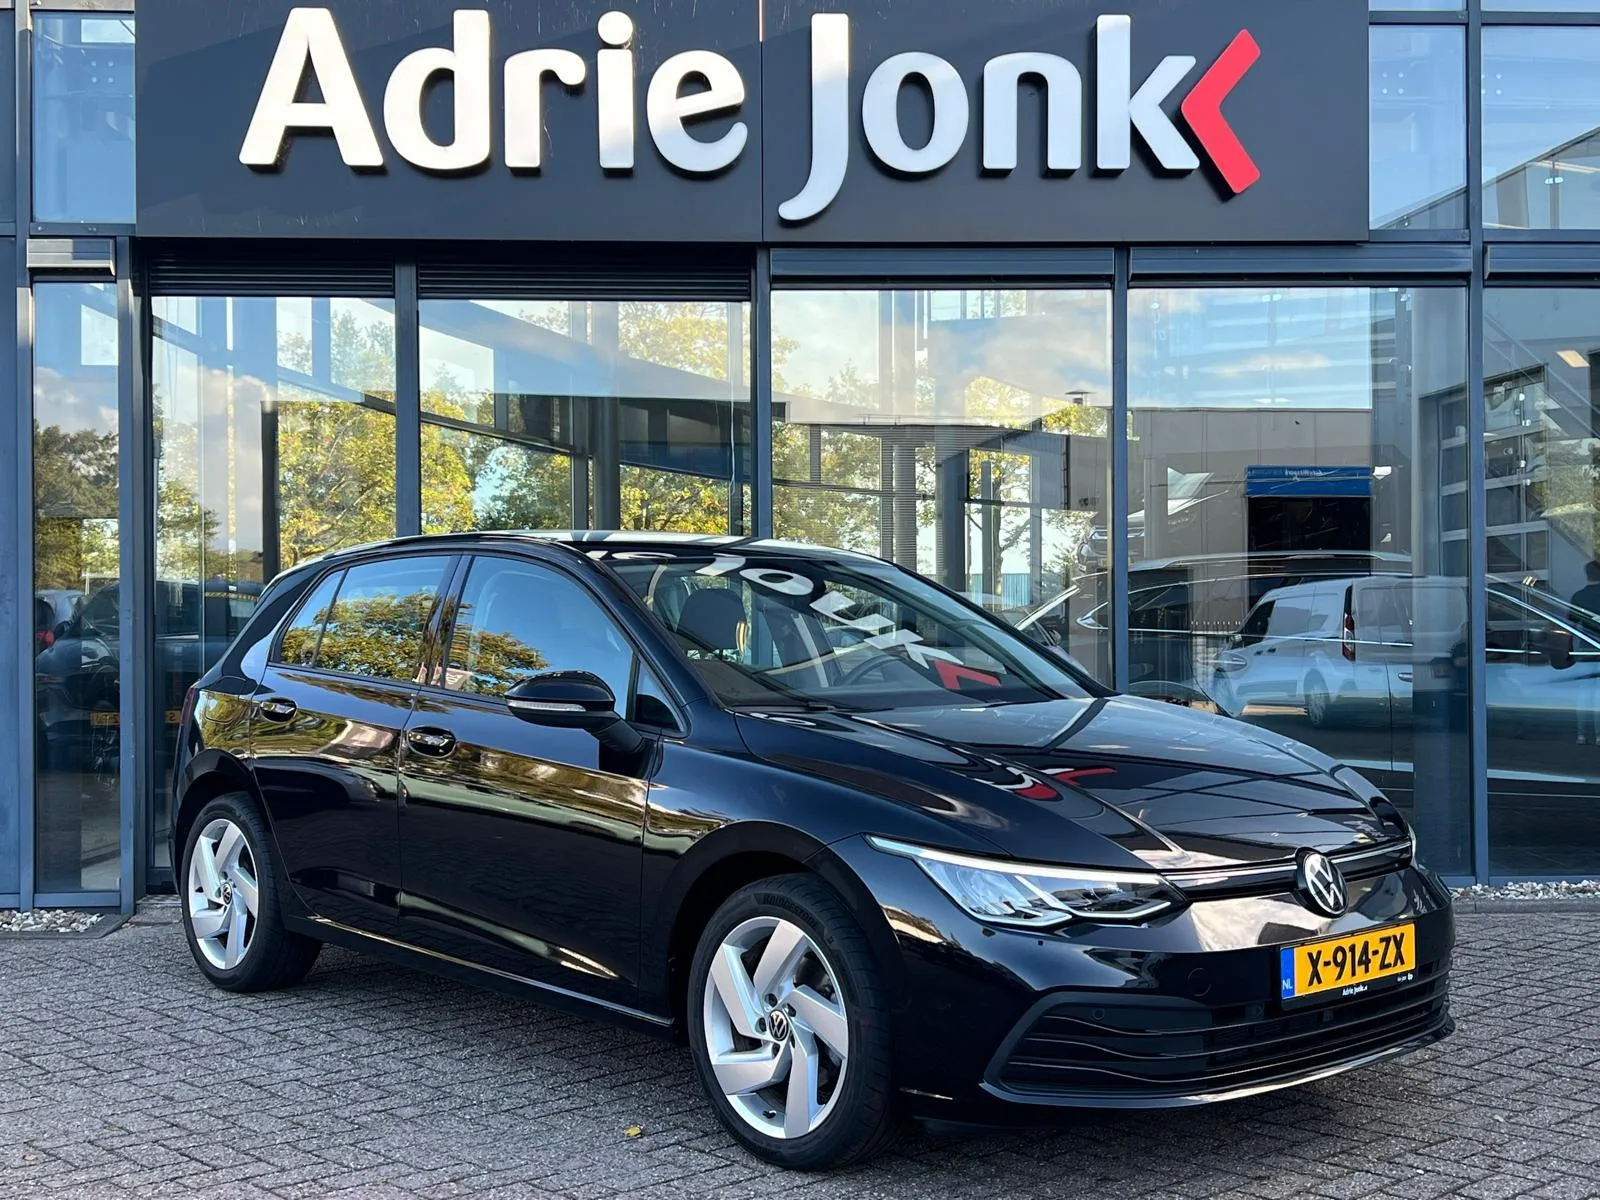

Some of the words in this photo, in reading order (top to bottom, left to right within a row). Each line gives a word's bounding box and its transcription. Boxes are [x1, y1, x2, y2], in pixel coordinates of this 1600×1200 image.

[239, 7, 748, 172] Adrie
[779, 14, 1200, 221] Jonk
[1282, 979, 1293, 990] NL
[1307, 932, 1406, 987] X-914-ZX
